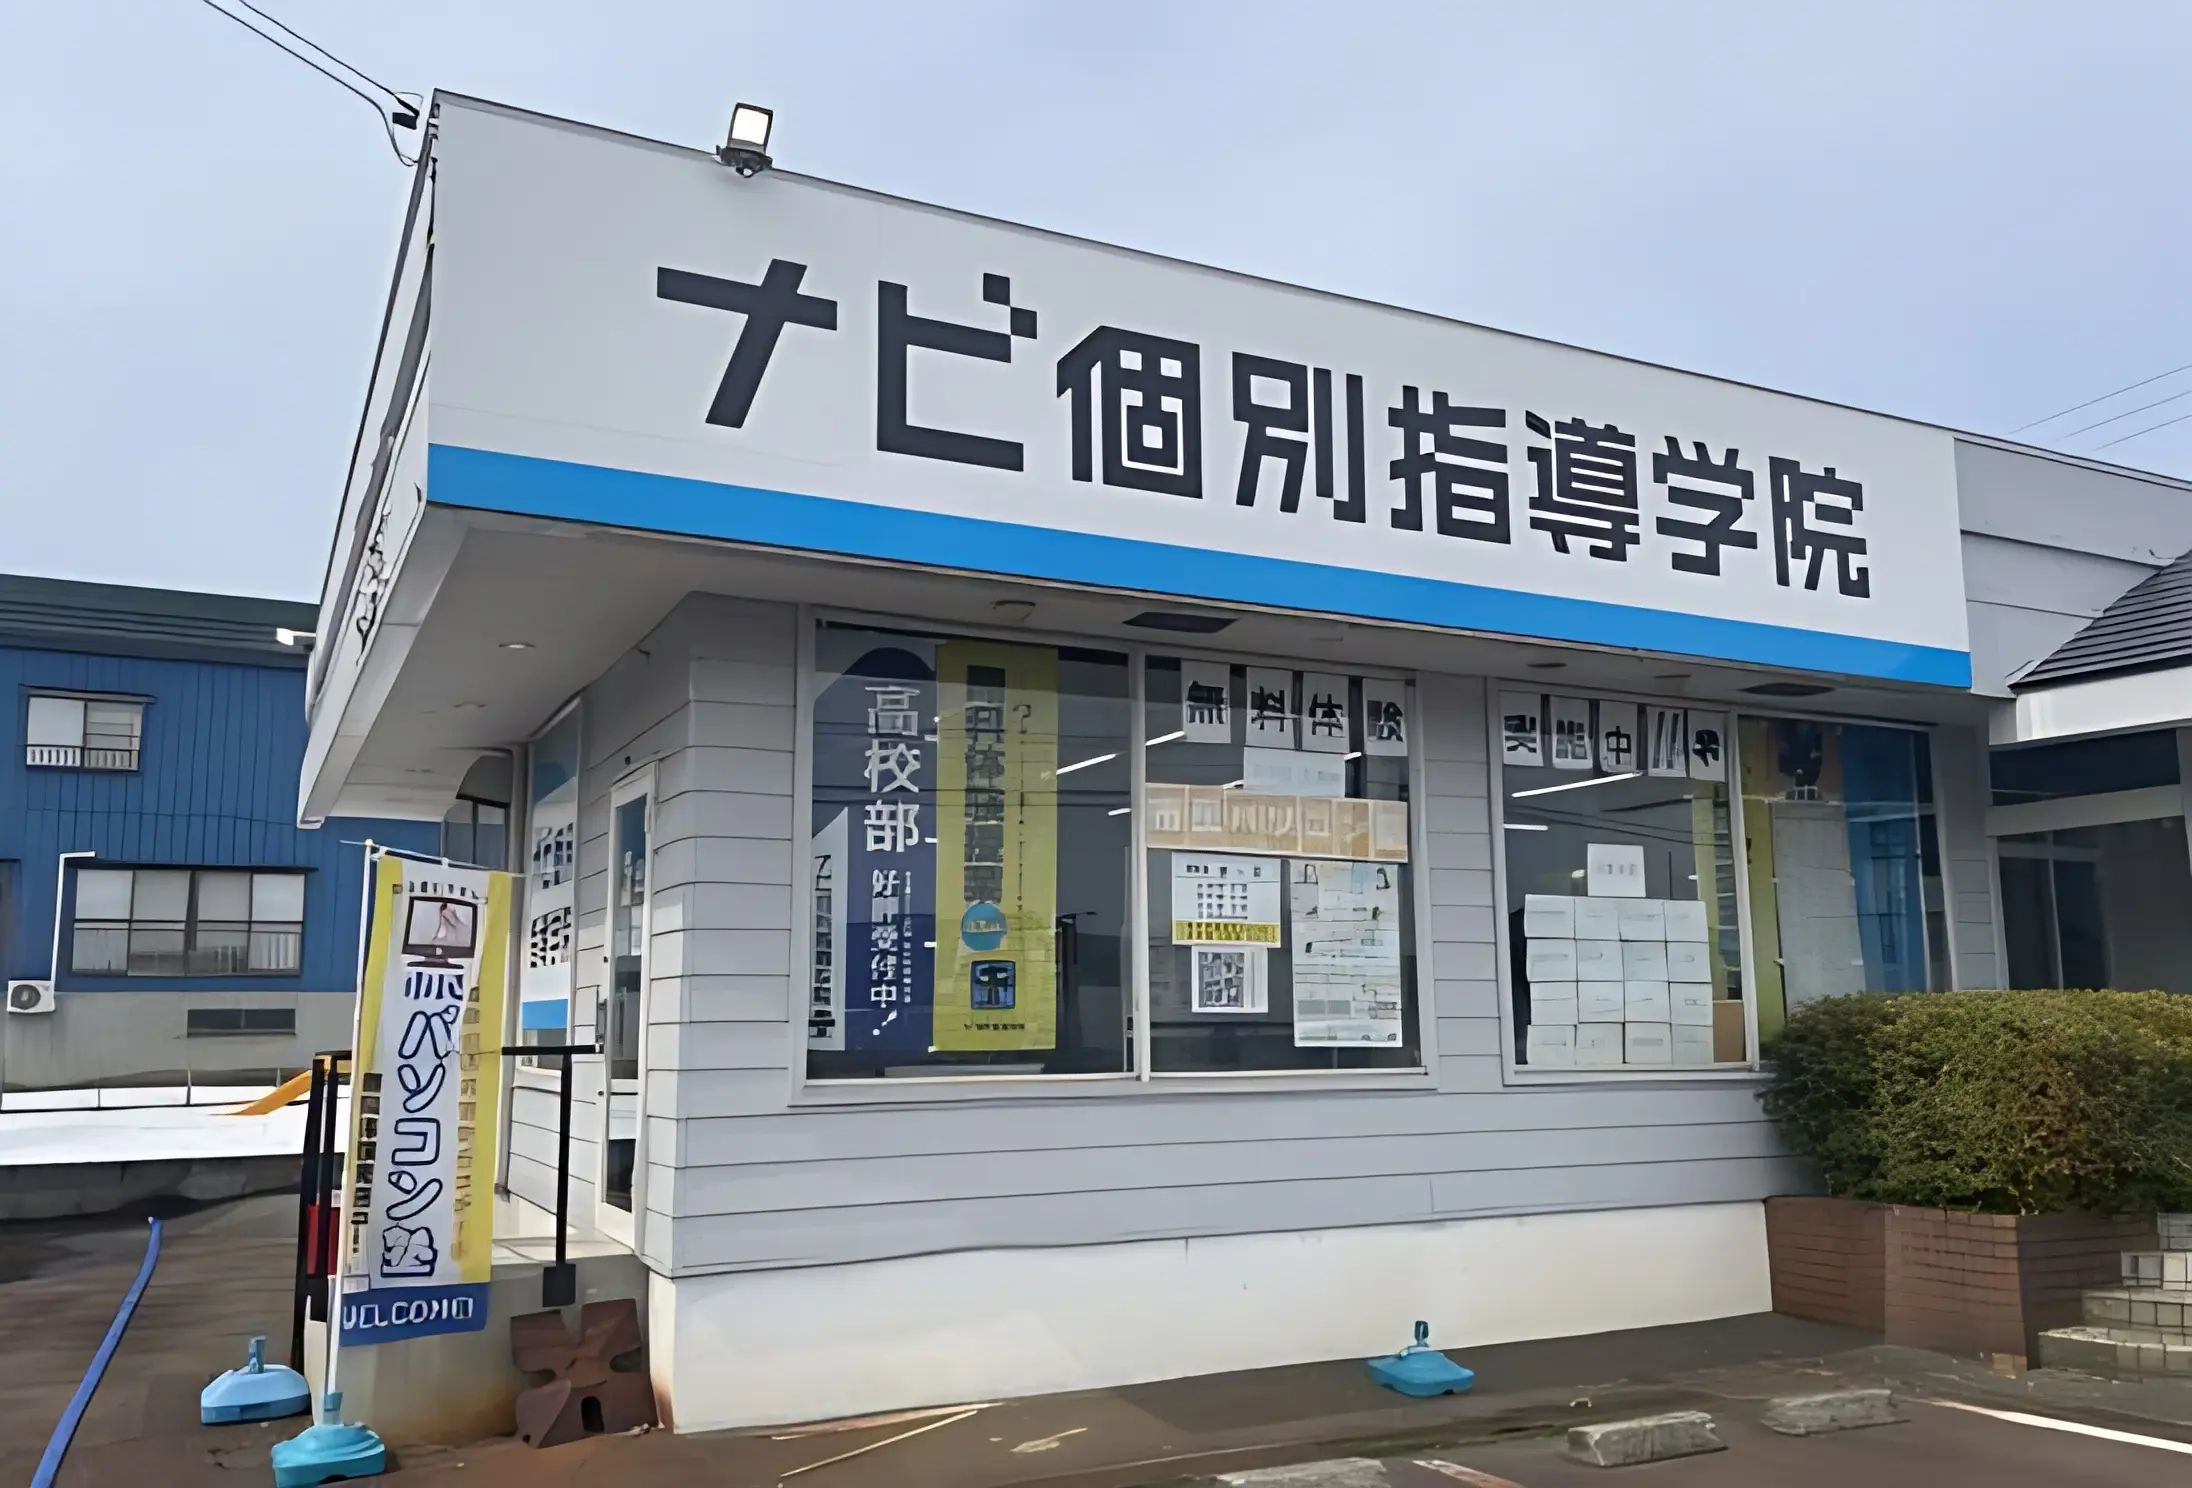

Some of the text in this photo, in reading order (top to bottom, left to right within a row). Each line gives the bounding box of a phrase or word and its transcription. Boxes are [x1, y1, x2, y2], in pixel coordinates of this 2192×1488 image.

[657, 259, 1870, 598] ナビ個別指導学院
[864, 685, 921, 852] 高校部
